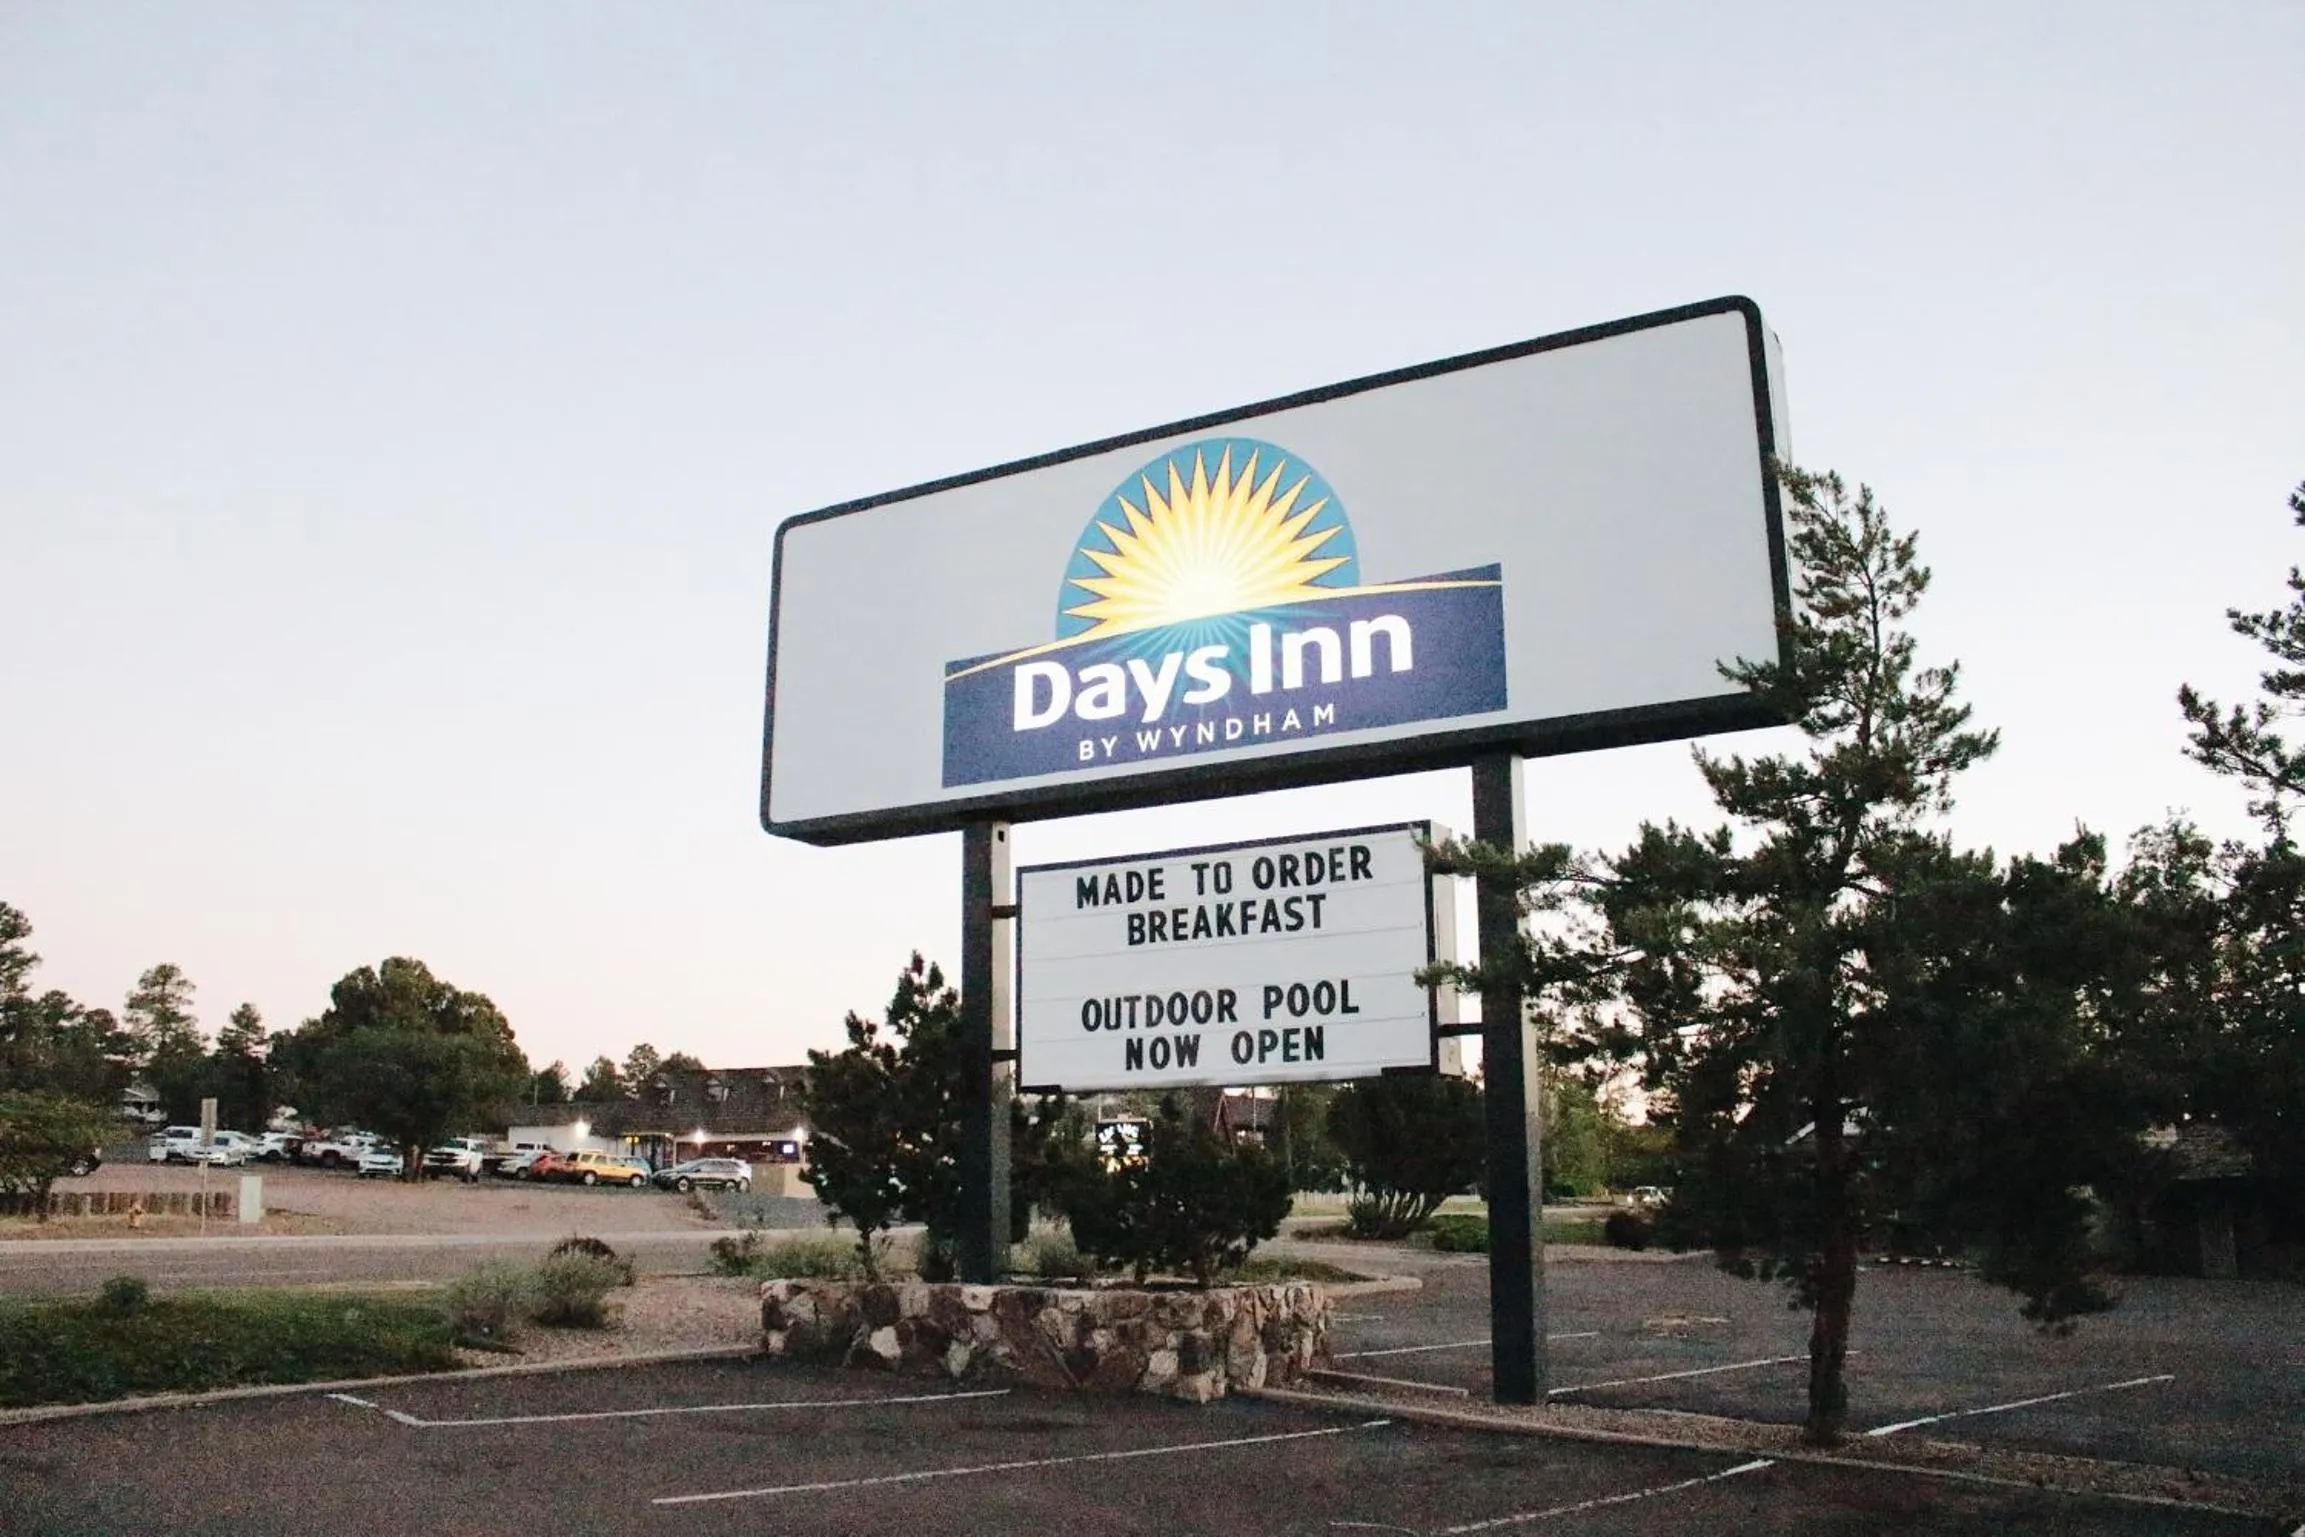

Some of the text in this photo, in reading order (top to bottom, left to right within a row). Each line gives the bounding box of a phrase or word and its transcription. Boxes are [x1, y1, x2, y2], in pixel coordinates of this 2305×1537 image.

[1013, 614, 1413, 733] Days Inn
[1078, 703, 1335, 761] BY WYNDHAM
[1076, 845, 1373, 909] MADE TO ORDER
[1127, 894, 1326, 946] BREAKFAST
[1082, 979, 1359, 1031] OUTDOOR POOL
[1125, 1026, 1324, 1070] NOW OPEN
